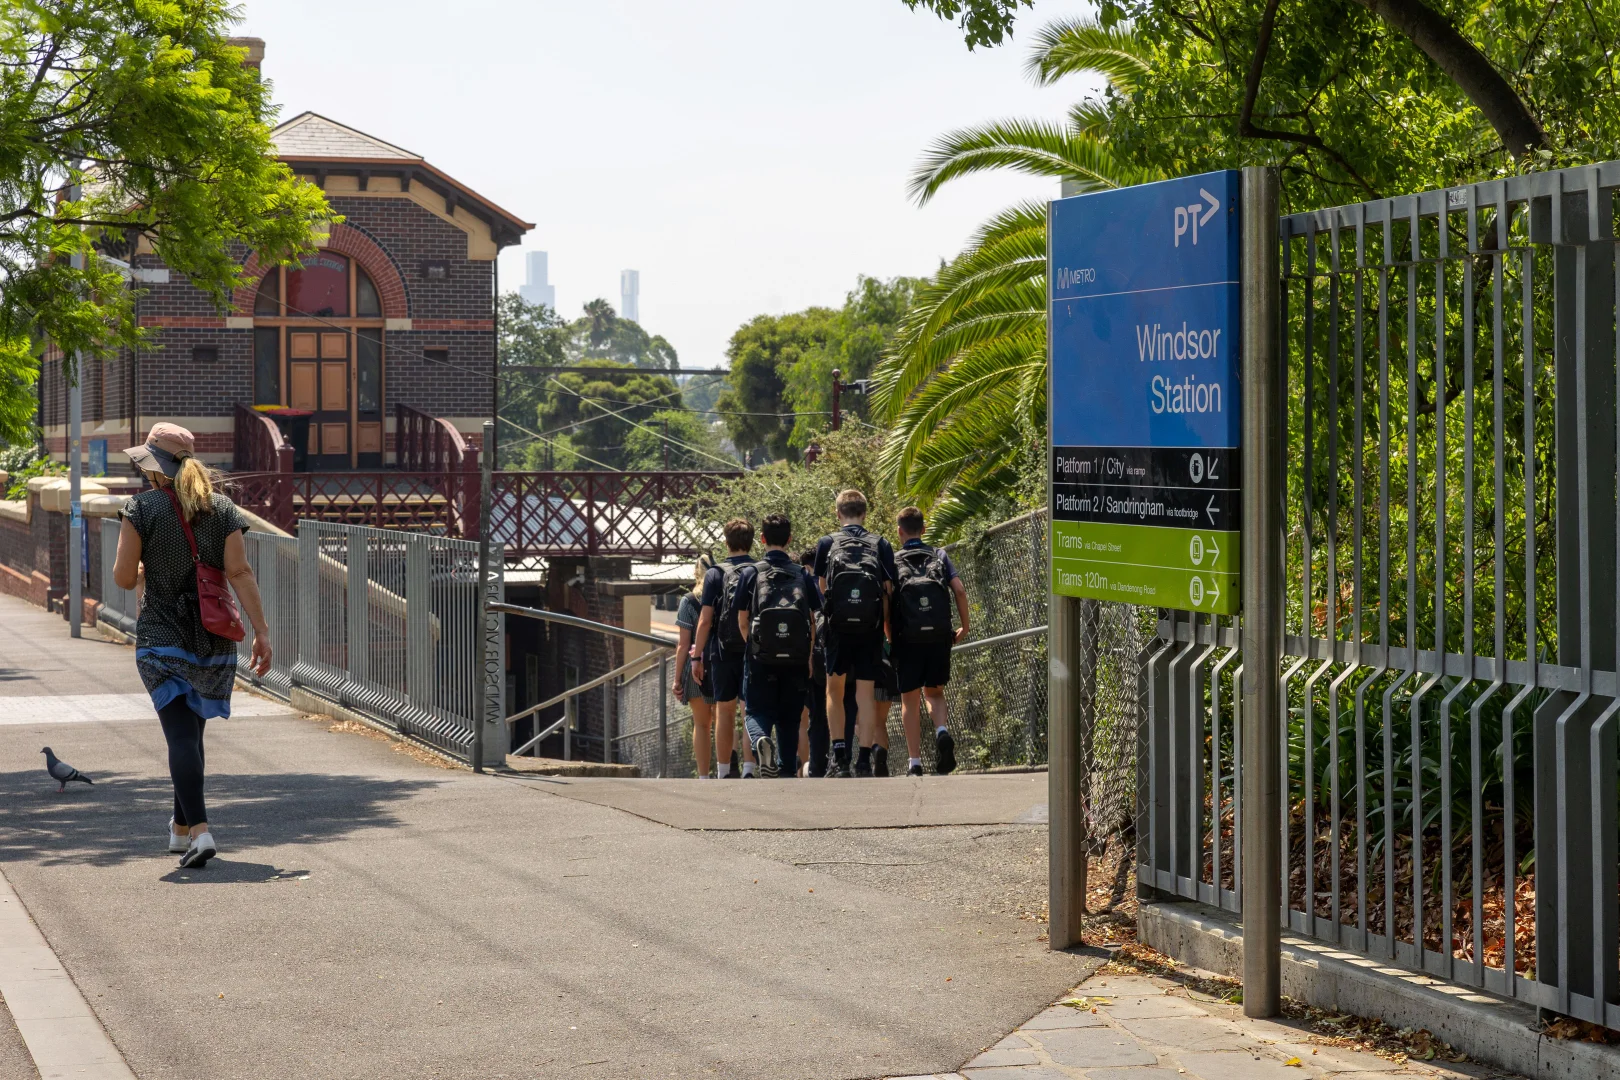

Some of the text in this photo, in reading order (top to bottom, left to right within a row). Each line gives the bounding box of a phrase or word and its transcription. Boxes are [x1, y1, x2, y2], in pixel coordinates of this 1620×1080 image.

[1069, 267, 1096, 285] METRO
[1136, 321, 1221, 362] Windsor
[1151, 374, 1222, 414] Station
[1056, 456, 1092, 474] Platform
[1106, 457, 1125, 479] City
[1126, 465, 1134, 475] via
[1133, 468, 1146, 477] ramp
[1056, 493, 1091, 512] Platform
[1093, 495, 1099, 512] 2
[1106, 495, 1164, 519] Sandringham
[1166, 507, 1174, 517] via
[1174, 507, 1199, 520] footbridge
[1056, 531, 1083, 549] Trams
[1091, 541, 1107, 552] Chapel
[1107, 542, 1122, 553] Street
[1056, 568, 1156, 595] Trams 120m via Dandenong Road
